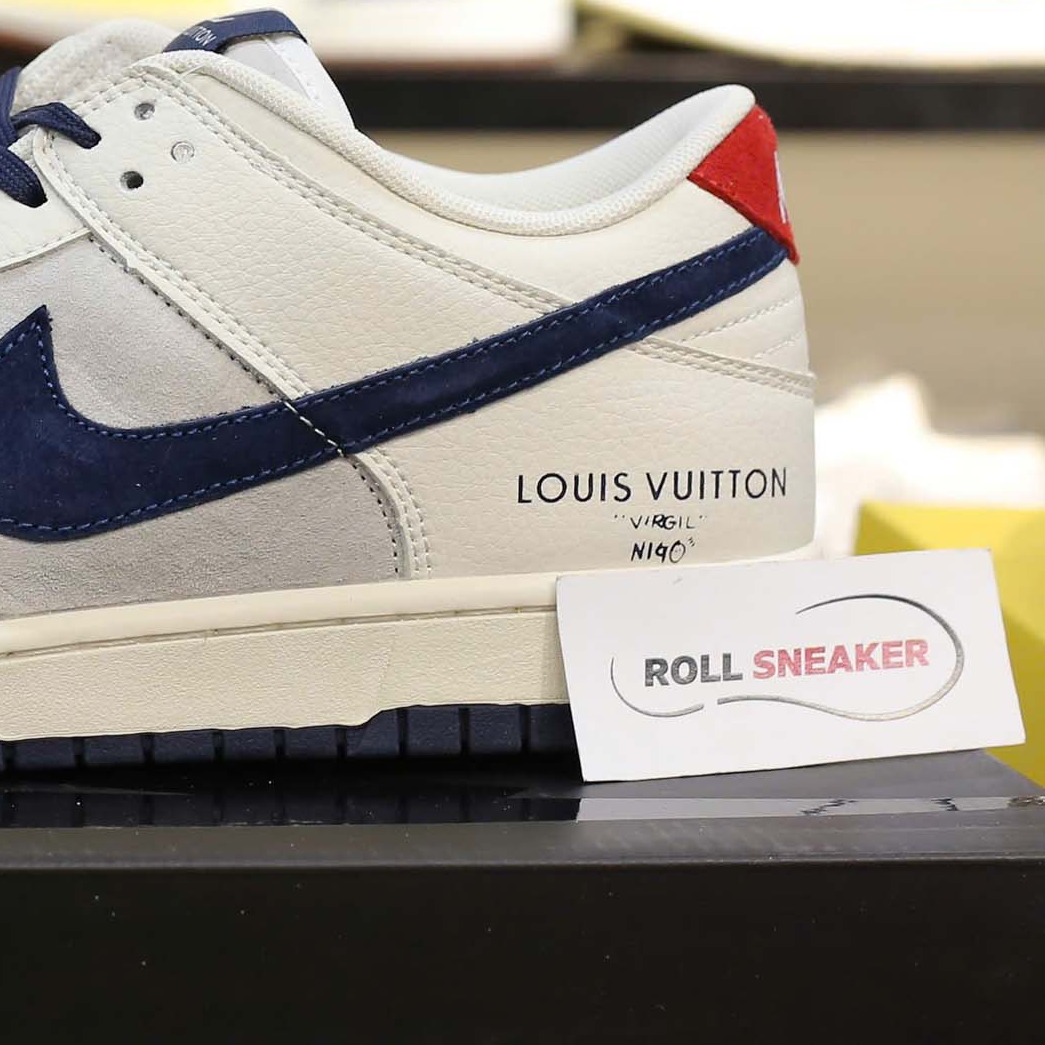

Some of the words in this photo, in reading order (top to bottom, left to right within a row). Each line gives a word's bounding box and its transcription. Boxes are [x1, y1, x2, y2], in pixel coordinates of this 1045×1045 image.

[517, 472, 632, 503] LOUIS
[646, 467, 787, 500] VUITTON
[644, 652, 743, 687] ROLL
[753, 638, 929, 679] SNEAKER
